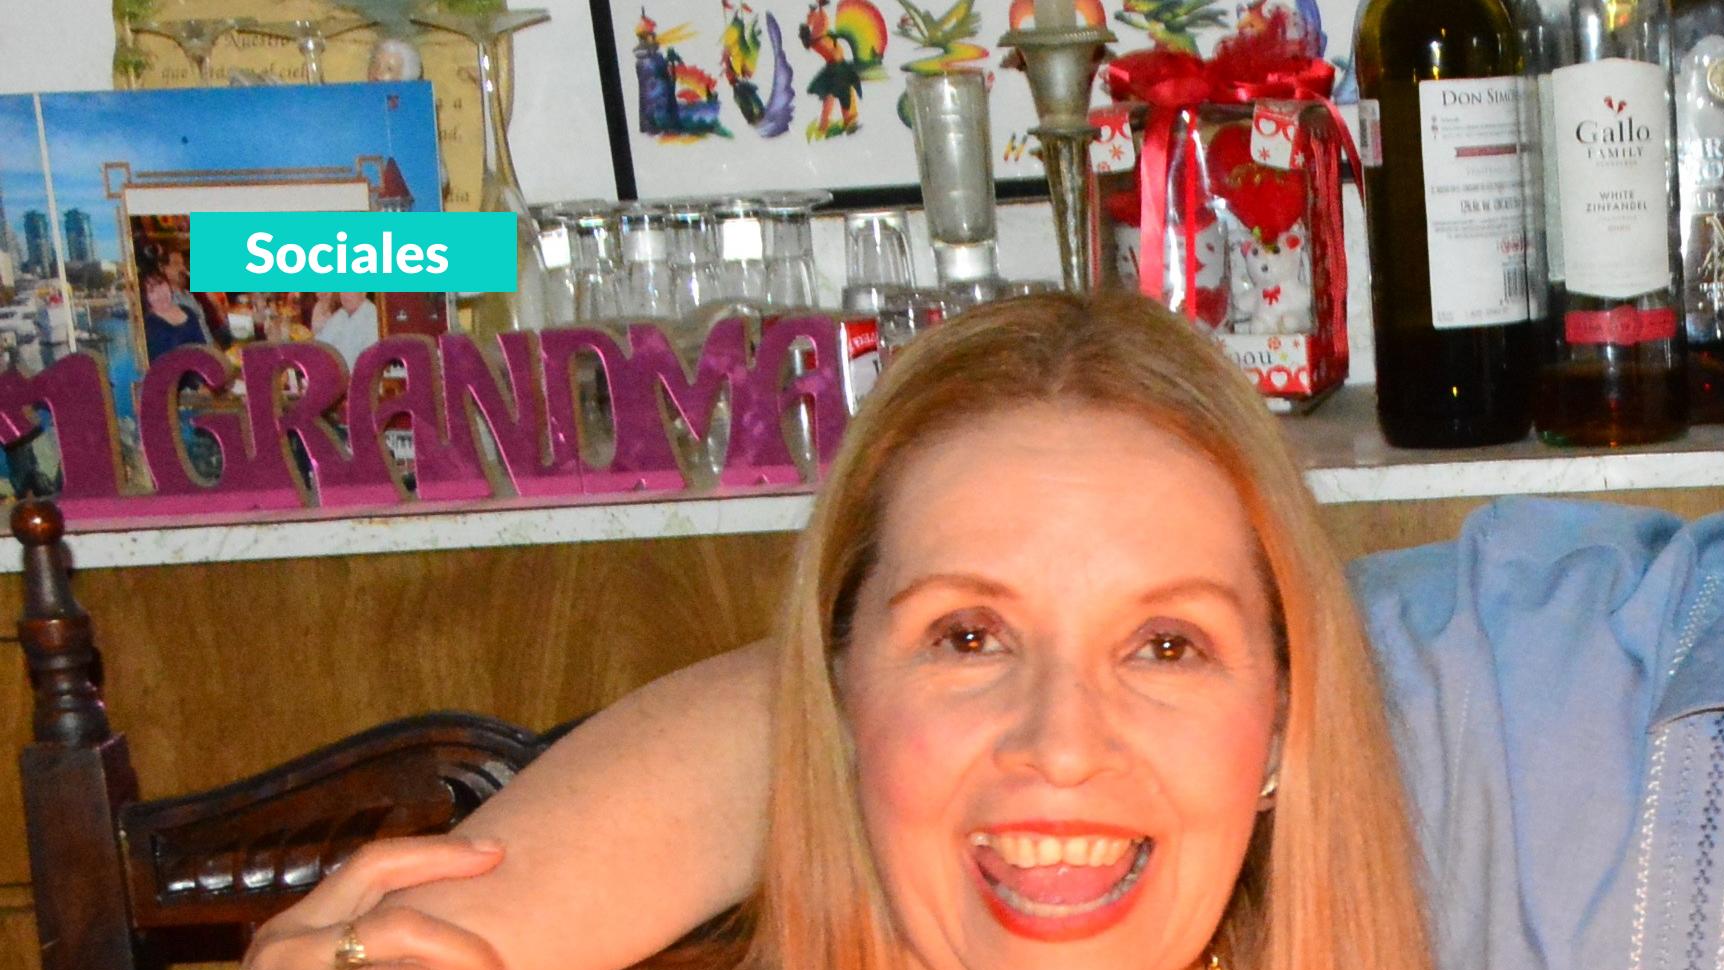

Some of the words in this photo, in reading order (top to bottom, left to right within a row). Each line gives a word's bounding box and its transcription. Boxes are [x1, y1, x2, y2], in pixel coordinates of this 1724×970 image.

[1442, 88, 1482, 106] DON
[1575, 116, 1651, 144] Gallo
[1586, 145, 1645, 159] FAMILY
[1599, 190, 1634, 200] WHITE
[1586, 200, 1648, 213] ZINFANDEL
[138, 314, 846, 502] GRANDMA
